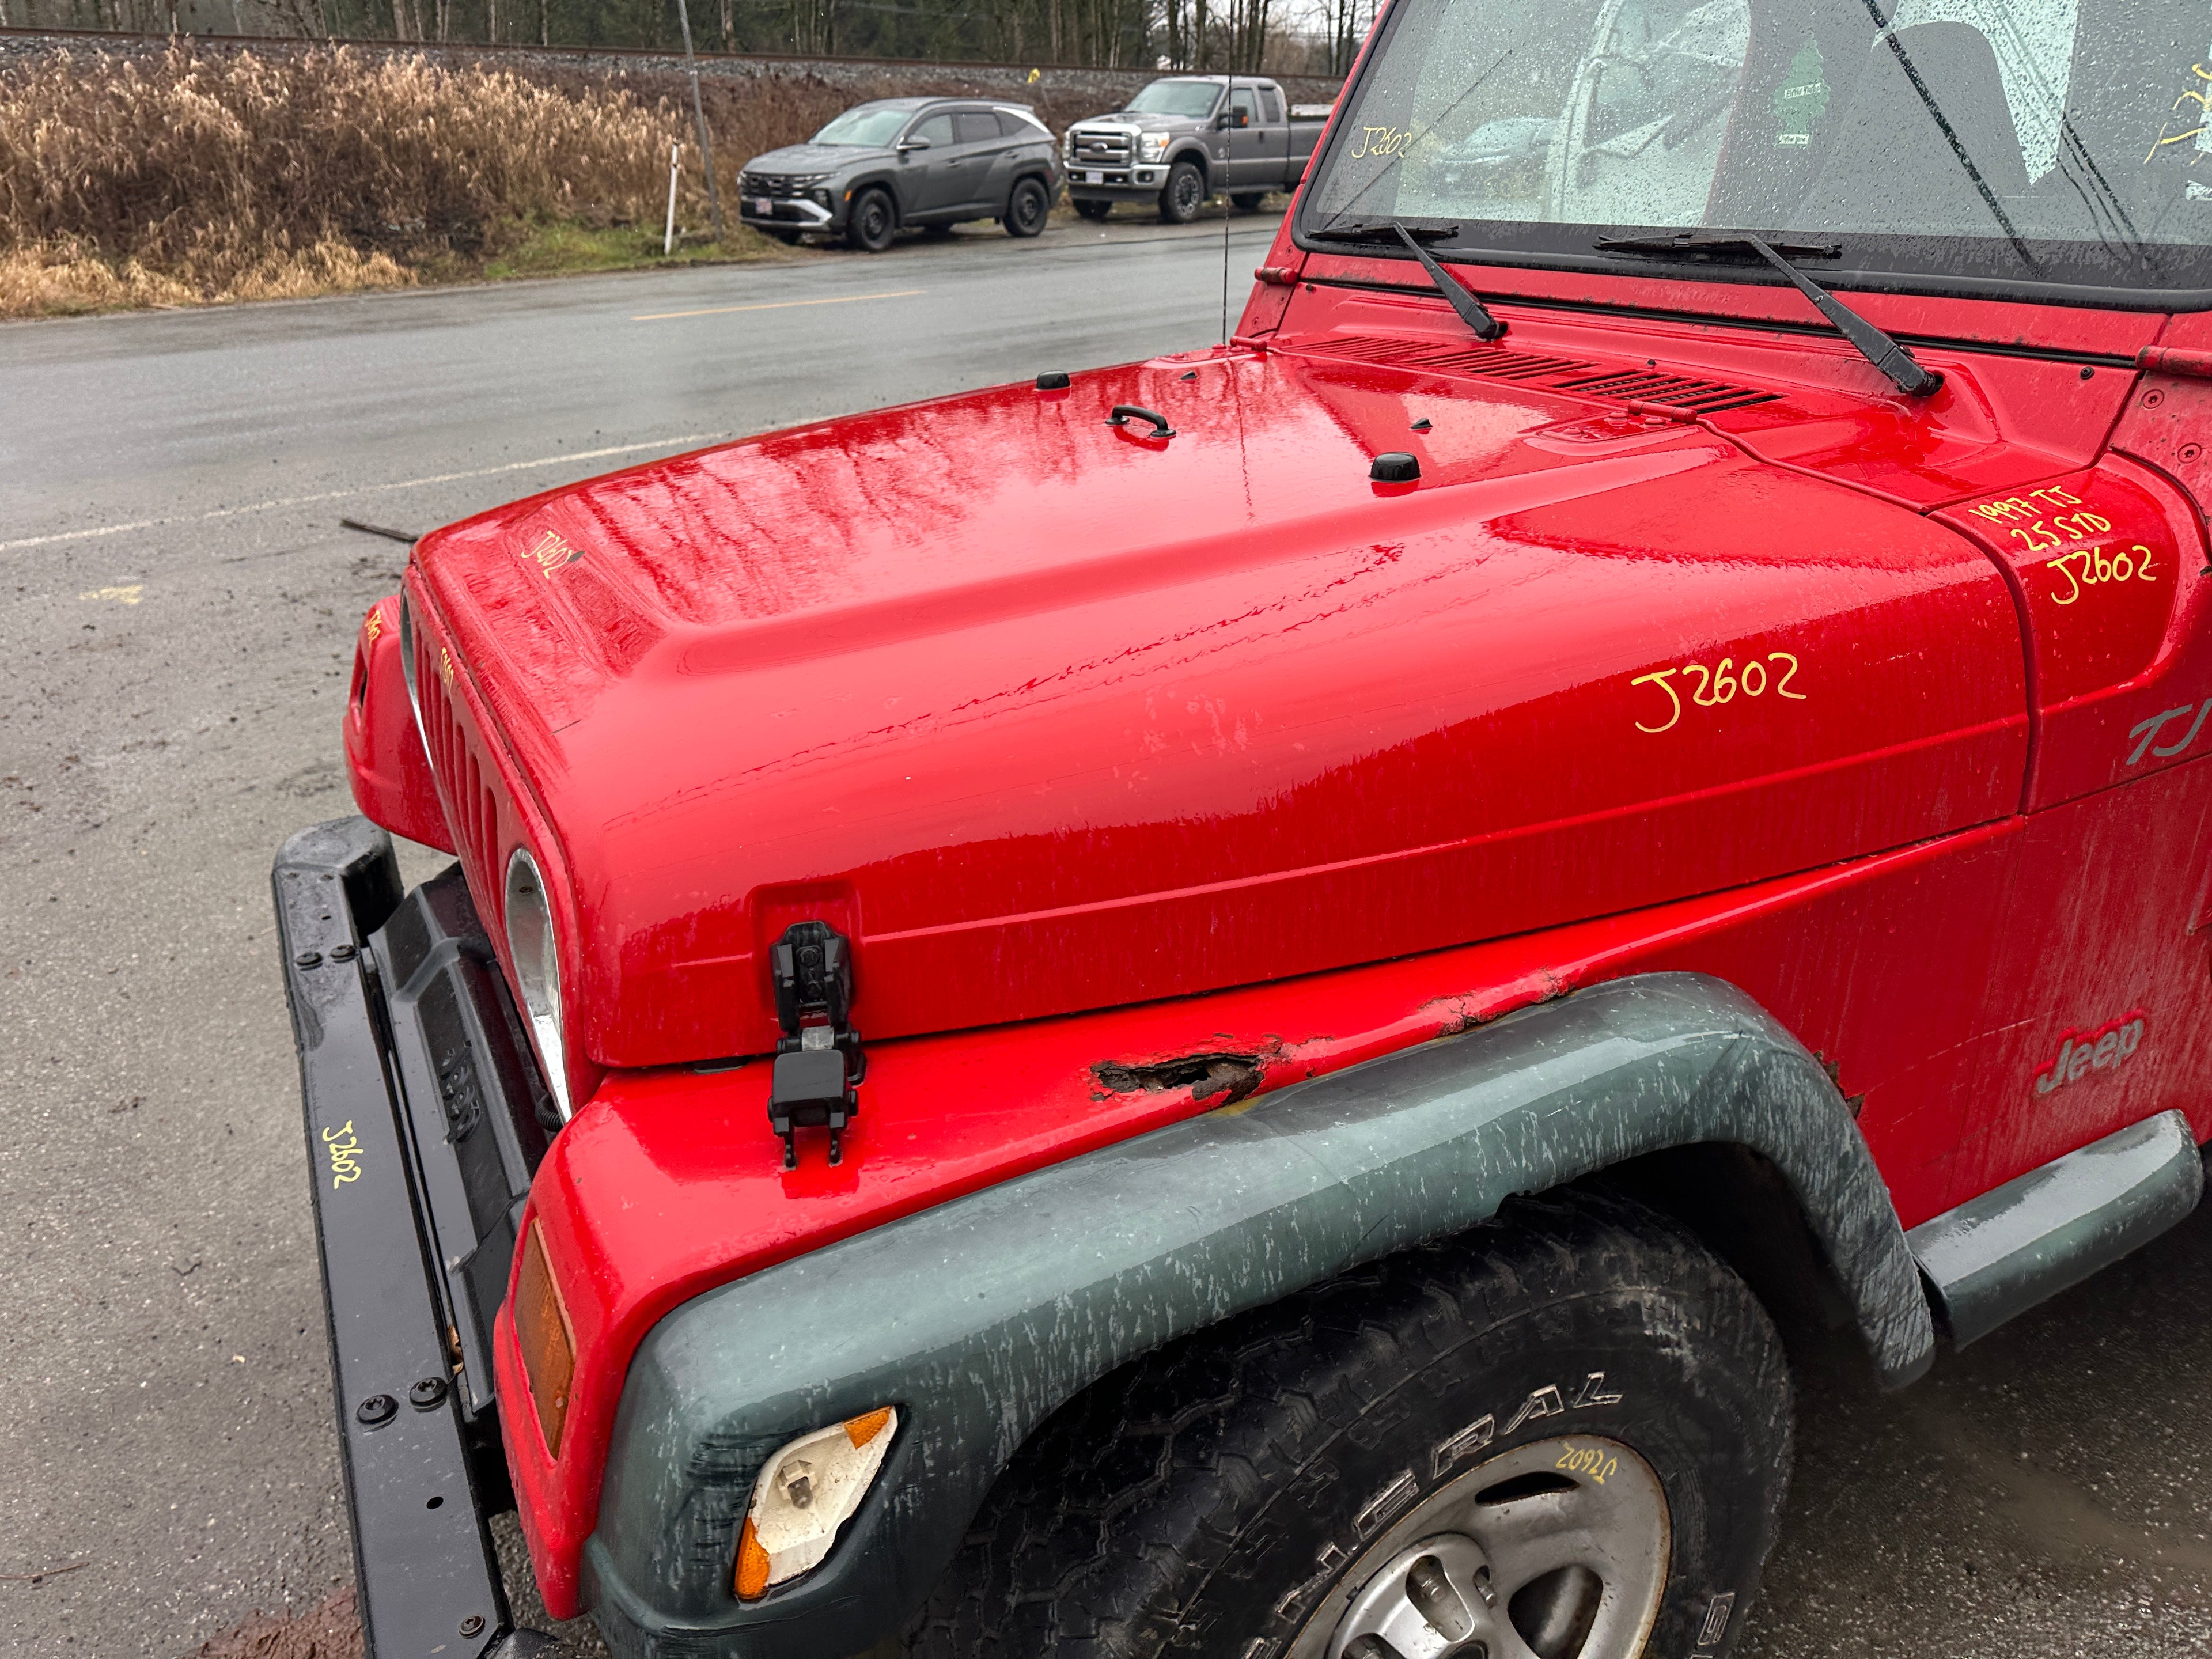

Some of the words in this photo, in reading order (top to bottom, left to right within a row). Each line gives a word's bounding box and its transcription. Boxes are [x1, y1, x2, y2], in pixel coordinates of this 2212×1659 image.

[1351, 127, 1412, 158] J2602
[1968, 497, 2042, 524] 1997
[2028, 485, 2082, 508] TJ
[2054, 512, 2111, 540] STD
[2047, 545, 2157, 605] J2602
[1631, 652, 1807, 733] J2602
[2126, 698, 2212, 765] TJ
[2037, 1018, 2145, 1093] Jeep
[323, 1120, 364, 1189] J2602
[1555, 1442, 1618, 1484] J2602
